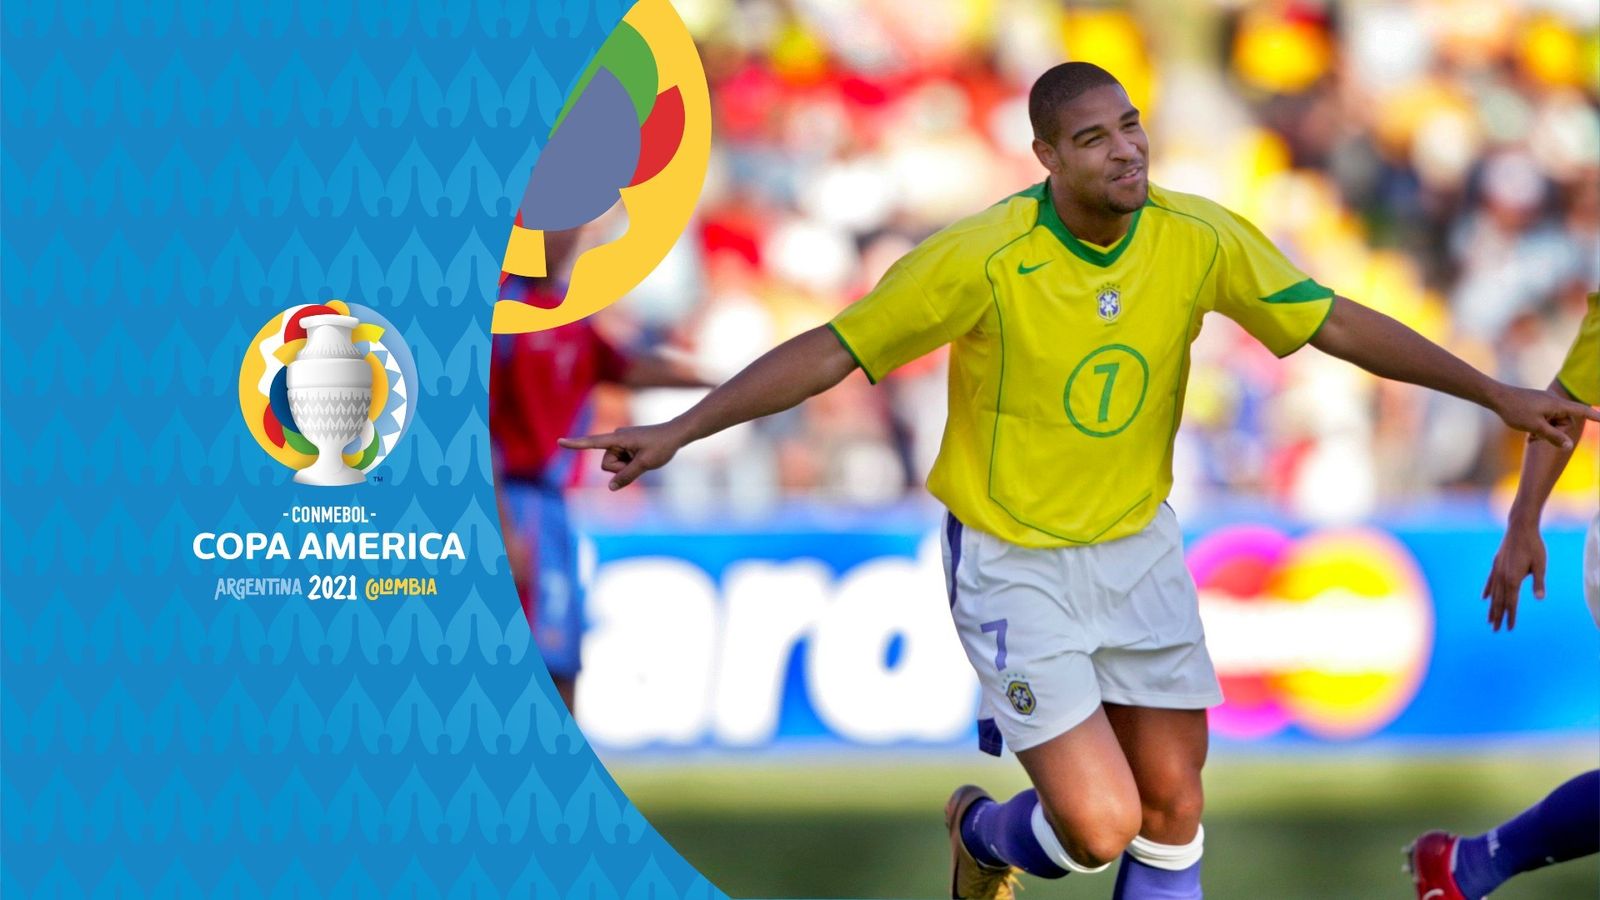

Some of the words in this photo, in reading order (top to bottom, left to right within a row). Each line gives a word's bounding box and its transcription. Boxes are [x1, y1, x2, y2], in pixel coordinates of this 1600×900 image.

[1093, 362, 1120, 423] 7
[574, 530, 979, 745] ard
[980, 618, 1008, 672] 7
